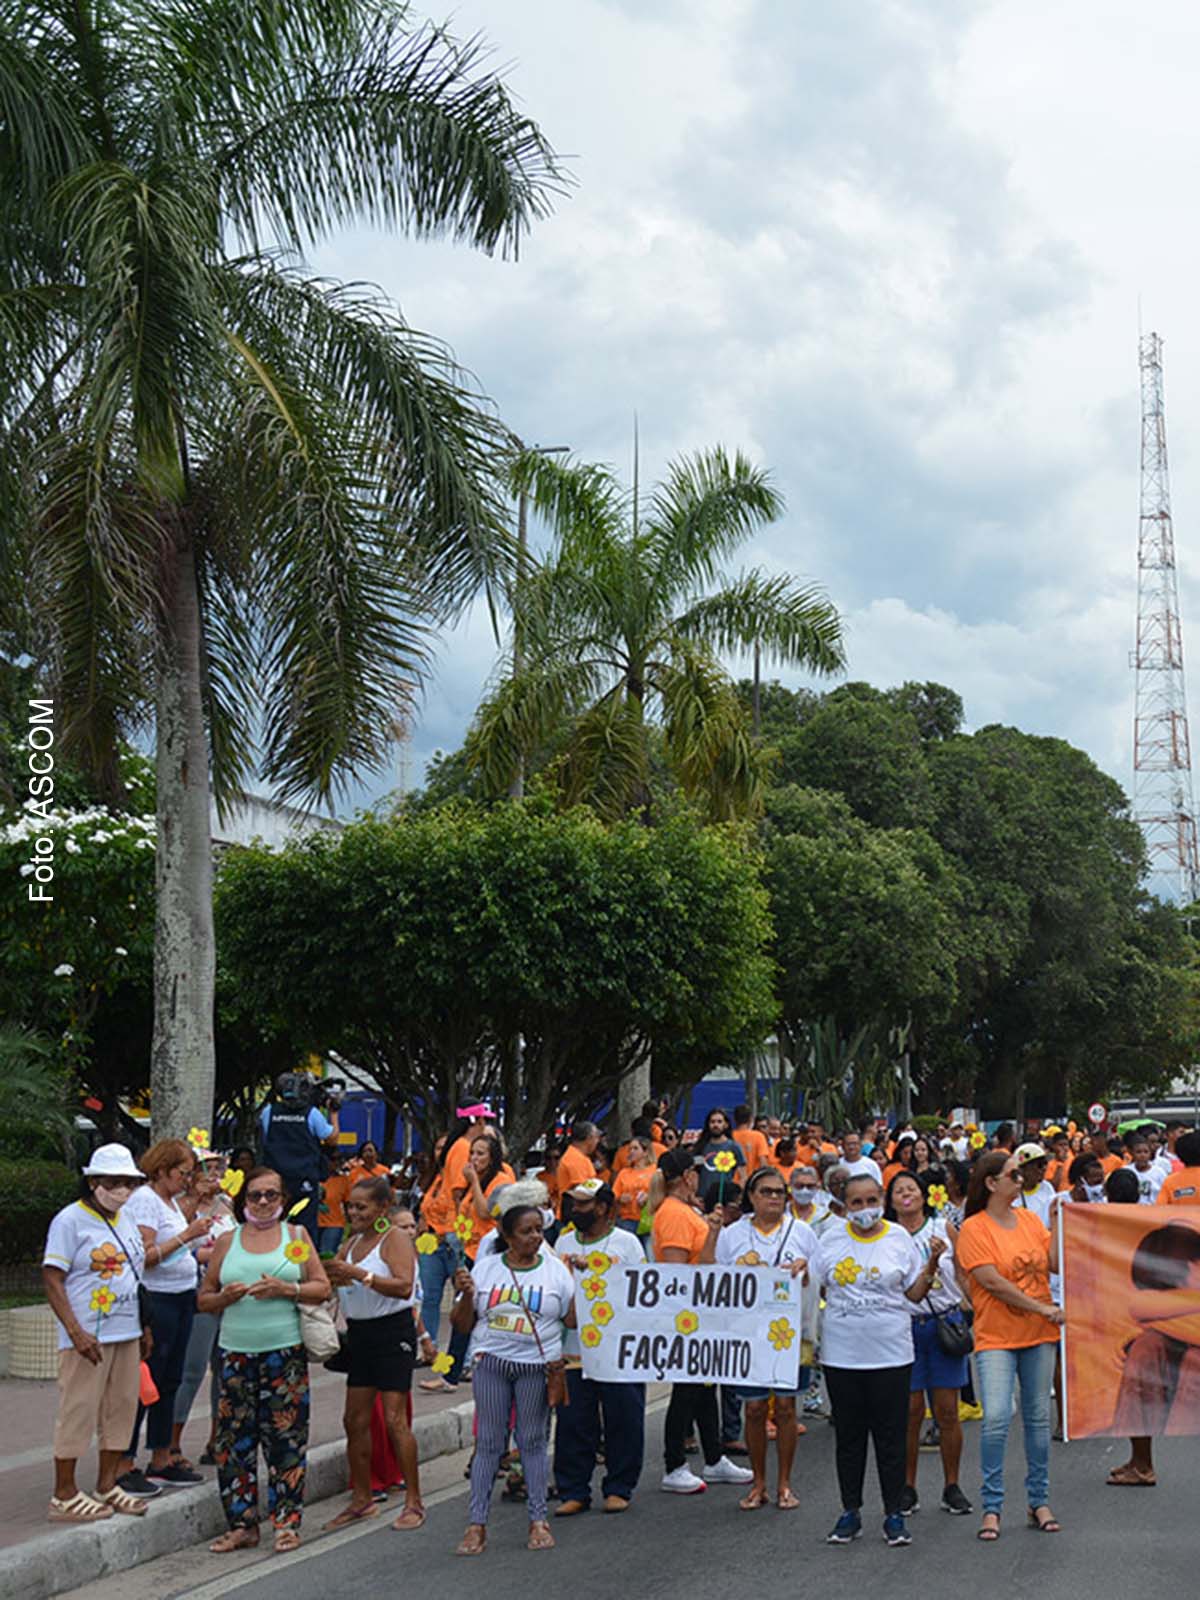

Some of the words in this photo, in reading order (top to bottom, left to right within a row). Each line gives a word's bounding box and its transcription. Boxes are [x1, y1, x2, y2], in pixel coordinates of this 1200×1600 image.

[625, 1269, 660, 1308] 18
[664, 1277, 687, 1297] de
[692, 1271, 758, 1308] MAIO
[617, 1334, 685, 1381] FAÇA
[687, 1338, 752, 1379] BONITO
